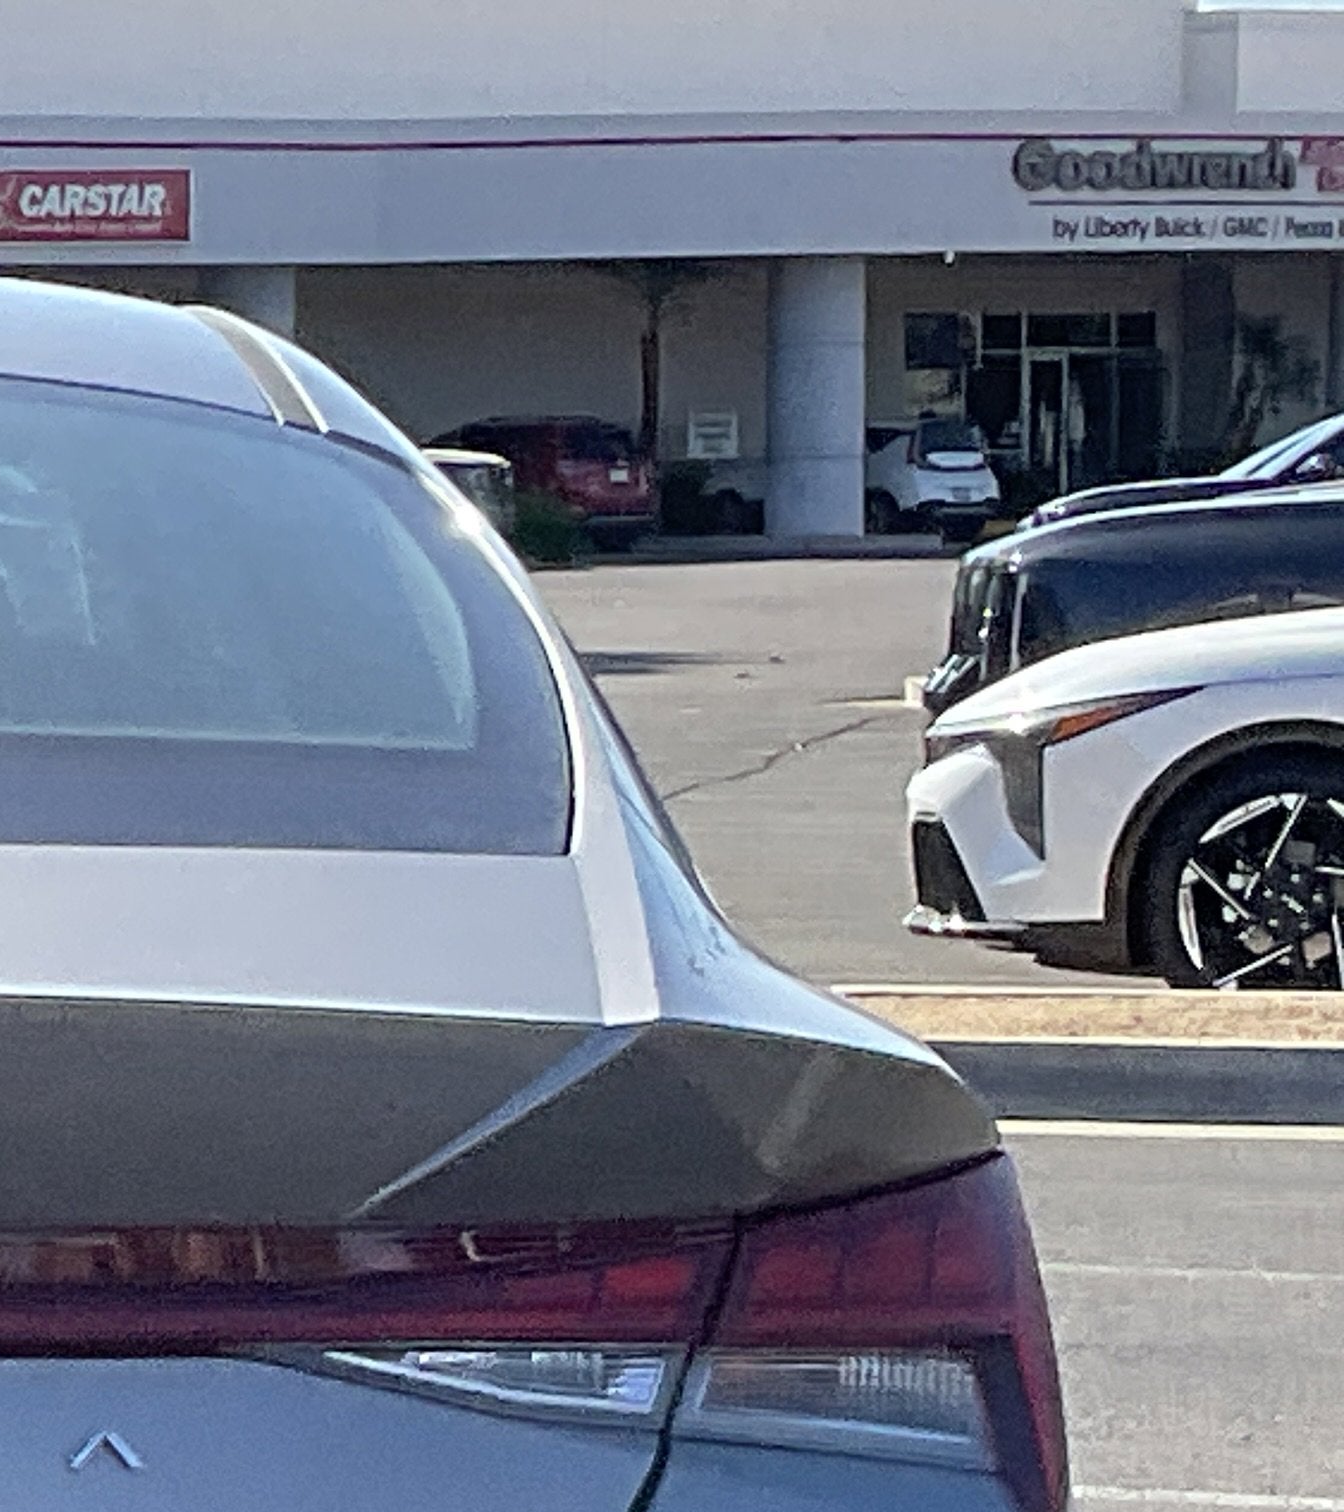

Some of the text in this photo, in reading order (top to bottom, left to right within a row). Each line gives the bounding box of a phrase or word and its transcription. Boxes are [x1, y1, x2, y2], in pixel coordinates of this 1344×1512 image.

[19, 183, 167, 217] CARSTAR
[1053, 216, 1078, 242] by
[1084, 215, 1149, 242] Liberty
[1224, 216, 1267, 237] GMC
